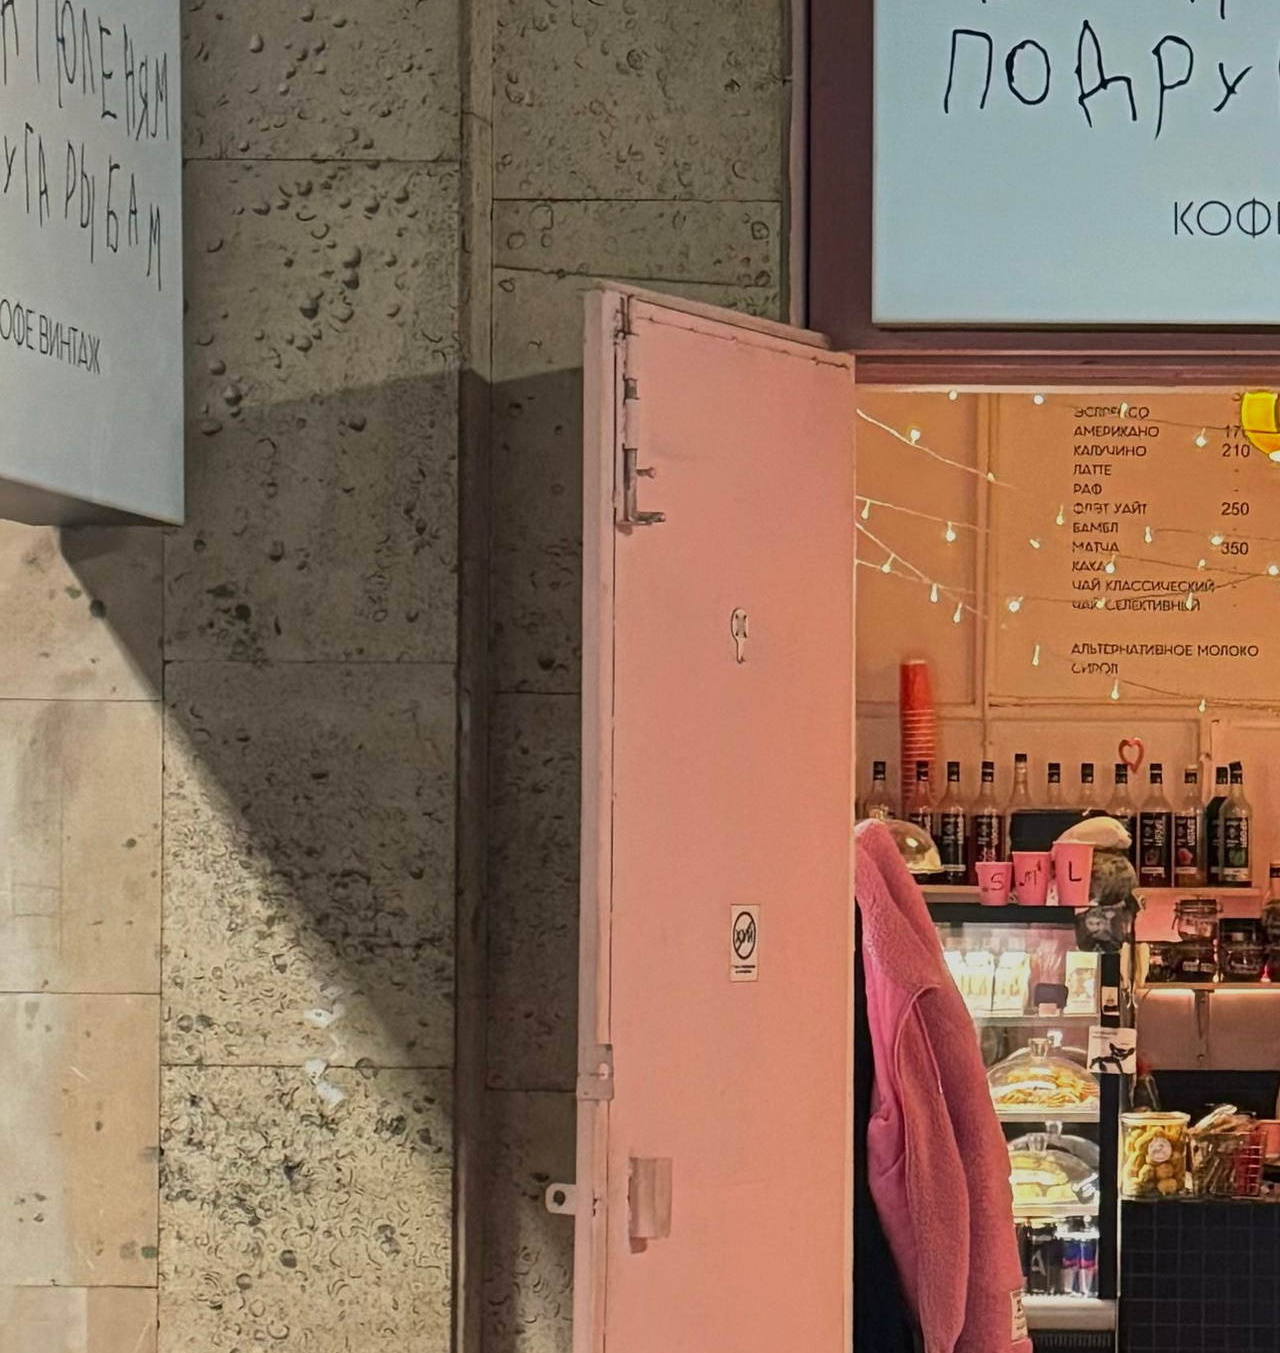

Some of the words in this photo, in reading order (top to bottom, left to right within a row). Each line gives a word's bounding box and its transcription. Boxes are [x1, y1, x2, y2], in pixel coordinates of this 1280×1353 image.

[64, 140, 162, 292] РЫБАМ
[0, 298, 35, 350] ОФЕ
[40, 313, 100, 374] ВИНТАЖ
[1073, 406, 1150, 419] ЭСПРЕСО
[1225, 425, 1246, 439] 17
[1073, 445, 1148, 457] КАПУЧИНО
[1221, 443, 1250, 458] 210
[1073, 464, 1112, 476] ЛАТТЕ
[1073, 483, 1103, 495] РАФ
[1072, 560, 1110, 572] КАКА
[1071, 643, 1193, 656] АЛЬТЕРНАТИВНОЕ
[1197, 644, 1260, 657] МОЛОКО
